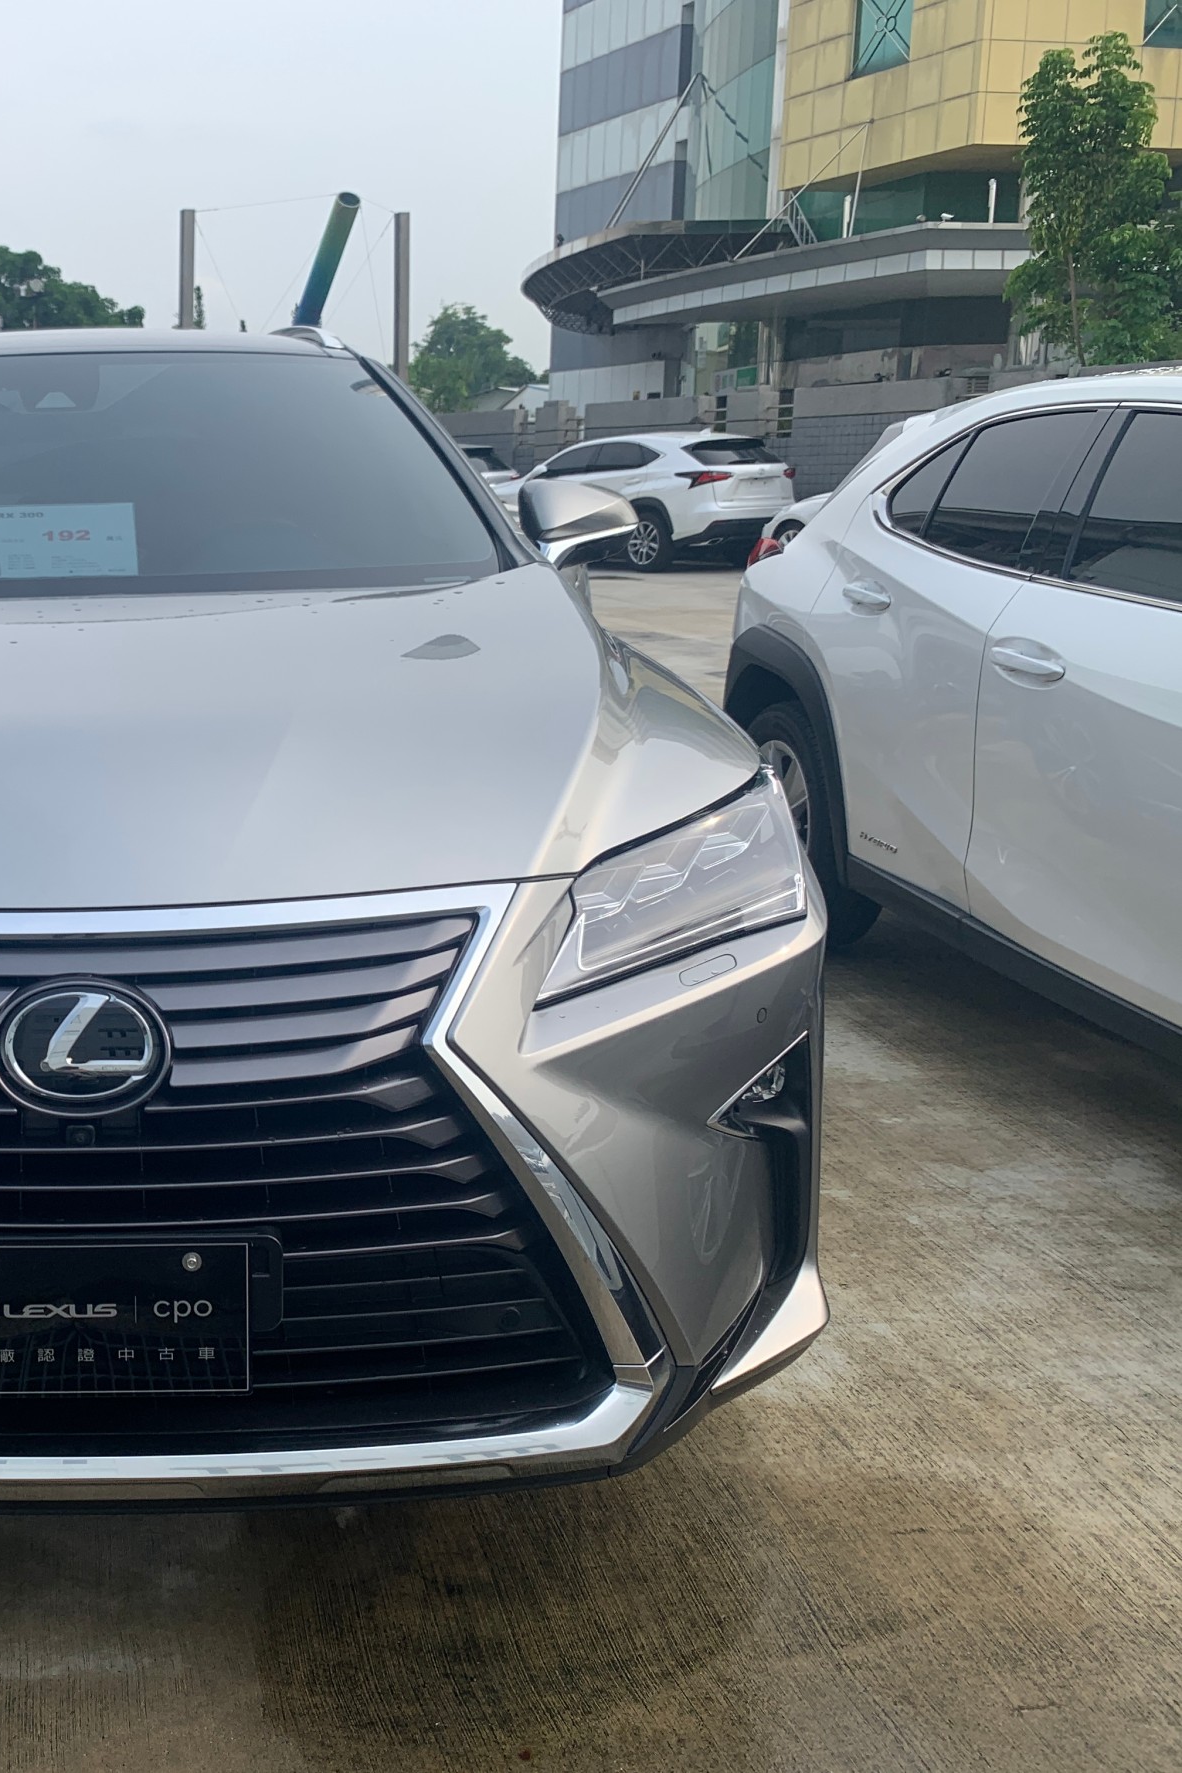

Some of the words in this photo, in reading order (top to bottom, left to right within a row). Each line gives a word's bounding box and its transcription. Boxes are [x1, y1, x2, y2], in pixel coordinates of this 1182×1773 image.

[19, 511, 44, 519] 300
[42, 529, 91, 541] 192
[3, 1302, 117, 1319] LEXUS
[153, 1300, 213, 1323] cpo
